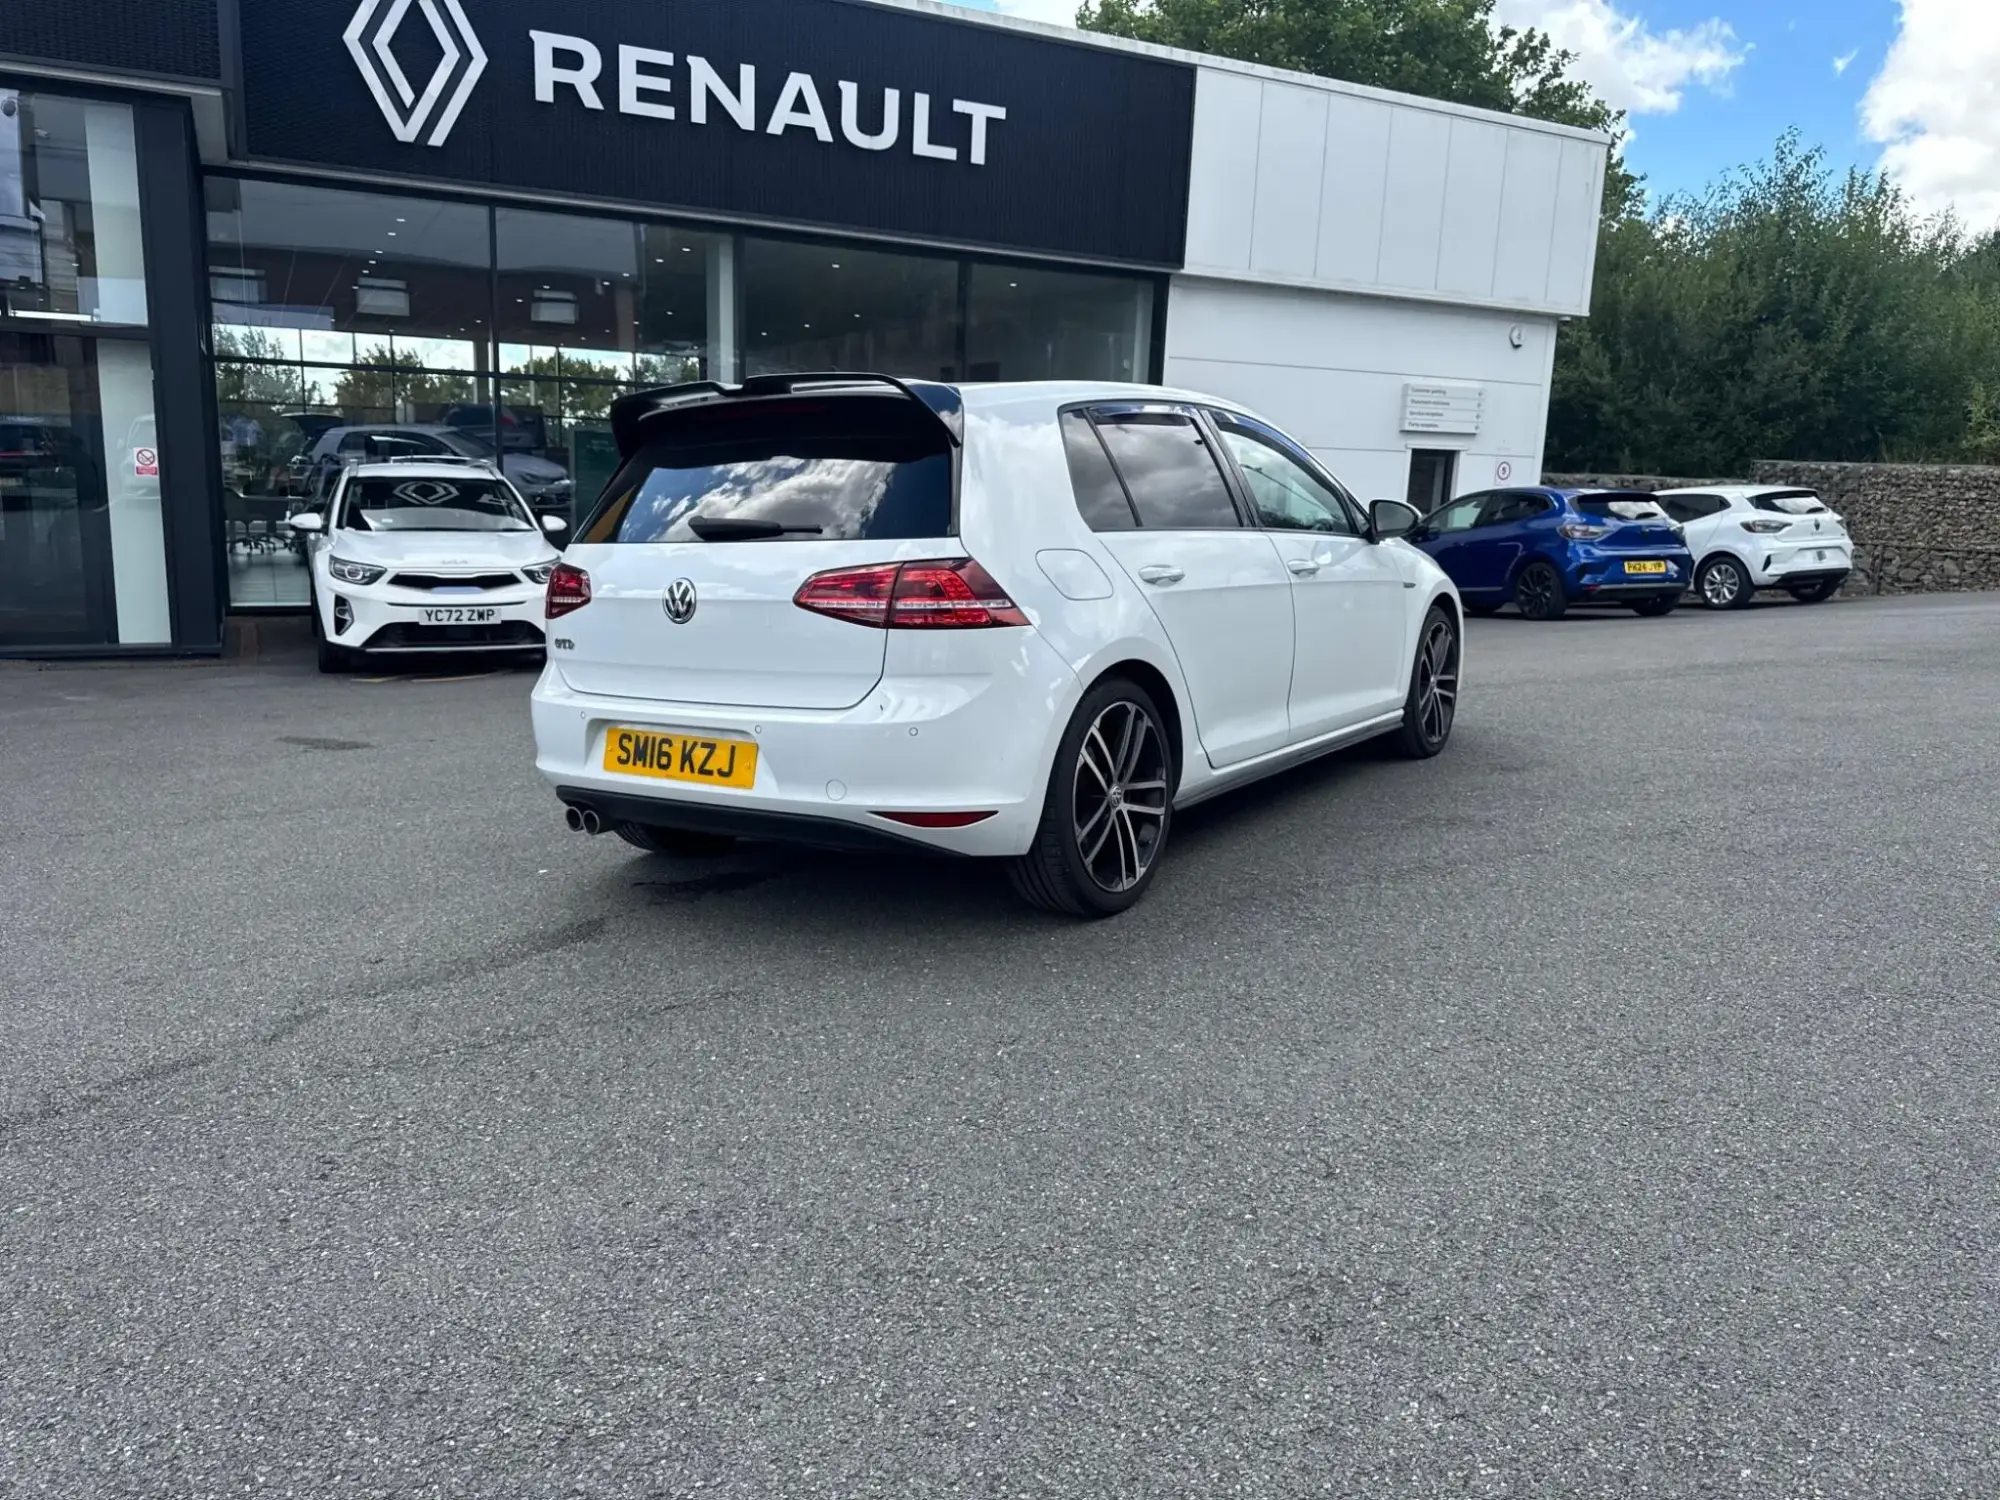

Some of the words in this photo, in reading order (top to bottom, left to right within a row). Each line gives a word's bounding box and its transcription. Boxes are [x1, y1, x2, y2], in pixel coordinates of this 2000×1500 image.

[529, 29, 1007, 165] RENAULT
[425, 609, 463, 622] YC72
[467, 608, 495, 622] ZWP
[616, 732, 674, 771] SM16
[679, 739, 737, 778] KZJ
